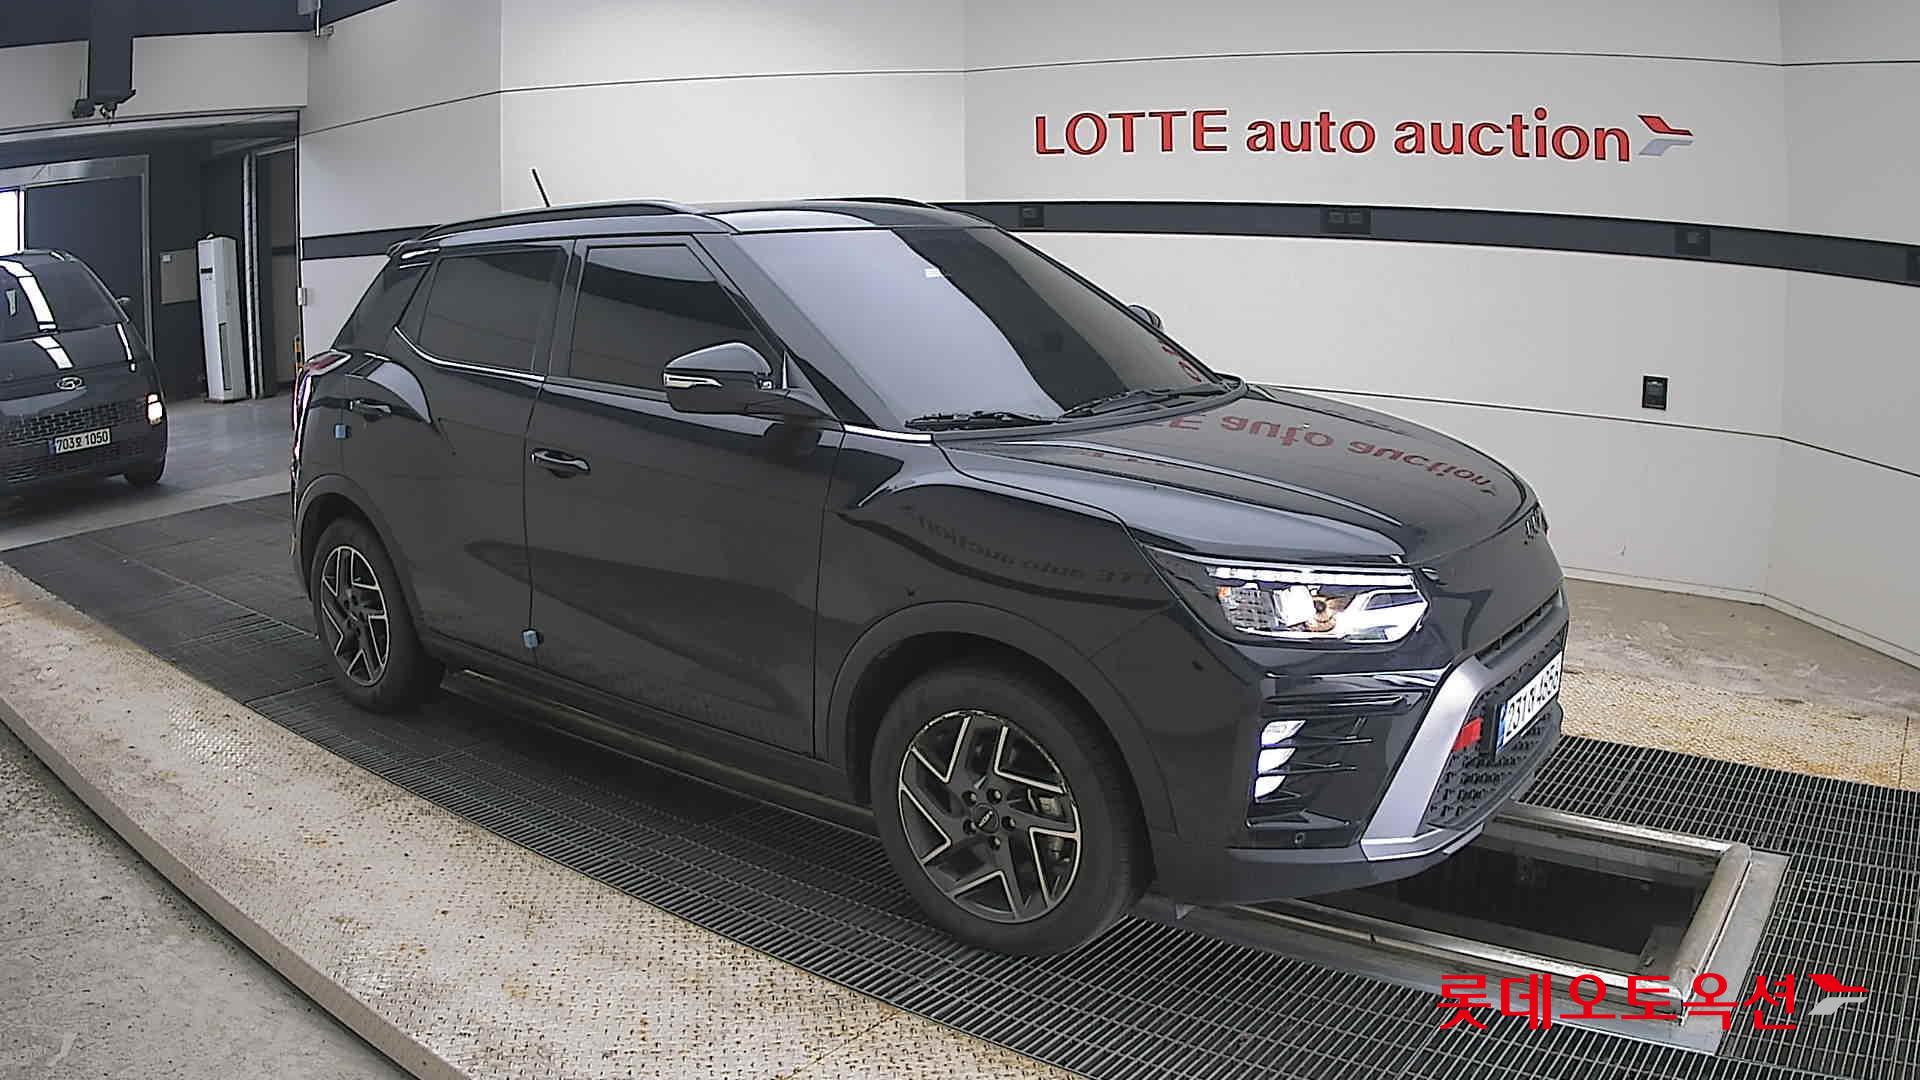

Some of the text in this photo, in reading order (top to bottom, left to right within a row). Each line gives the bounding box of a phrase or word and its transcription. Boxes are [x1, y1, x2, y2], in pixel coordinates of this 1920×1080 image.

[1035, 107, 1631, 163] LOTTE auto auction
[85, 430, 109, 446] 1050
